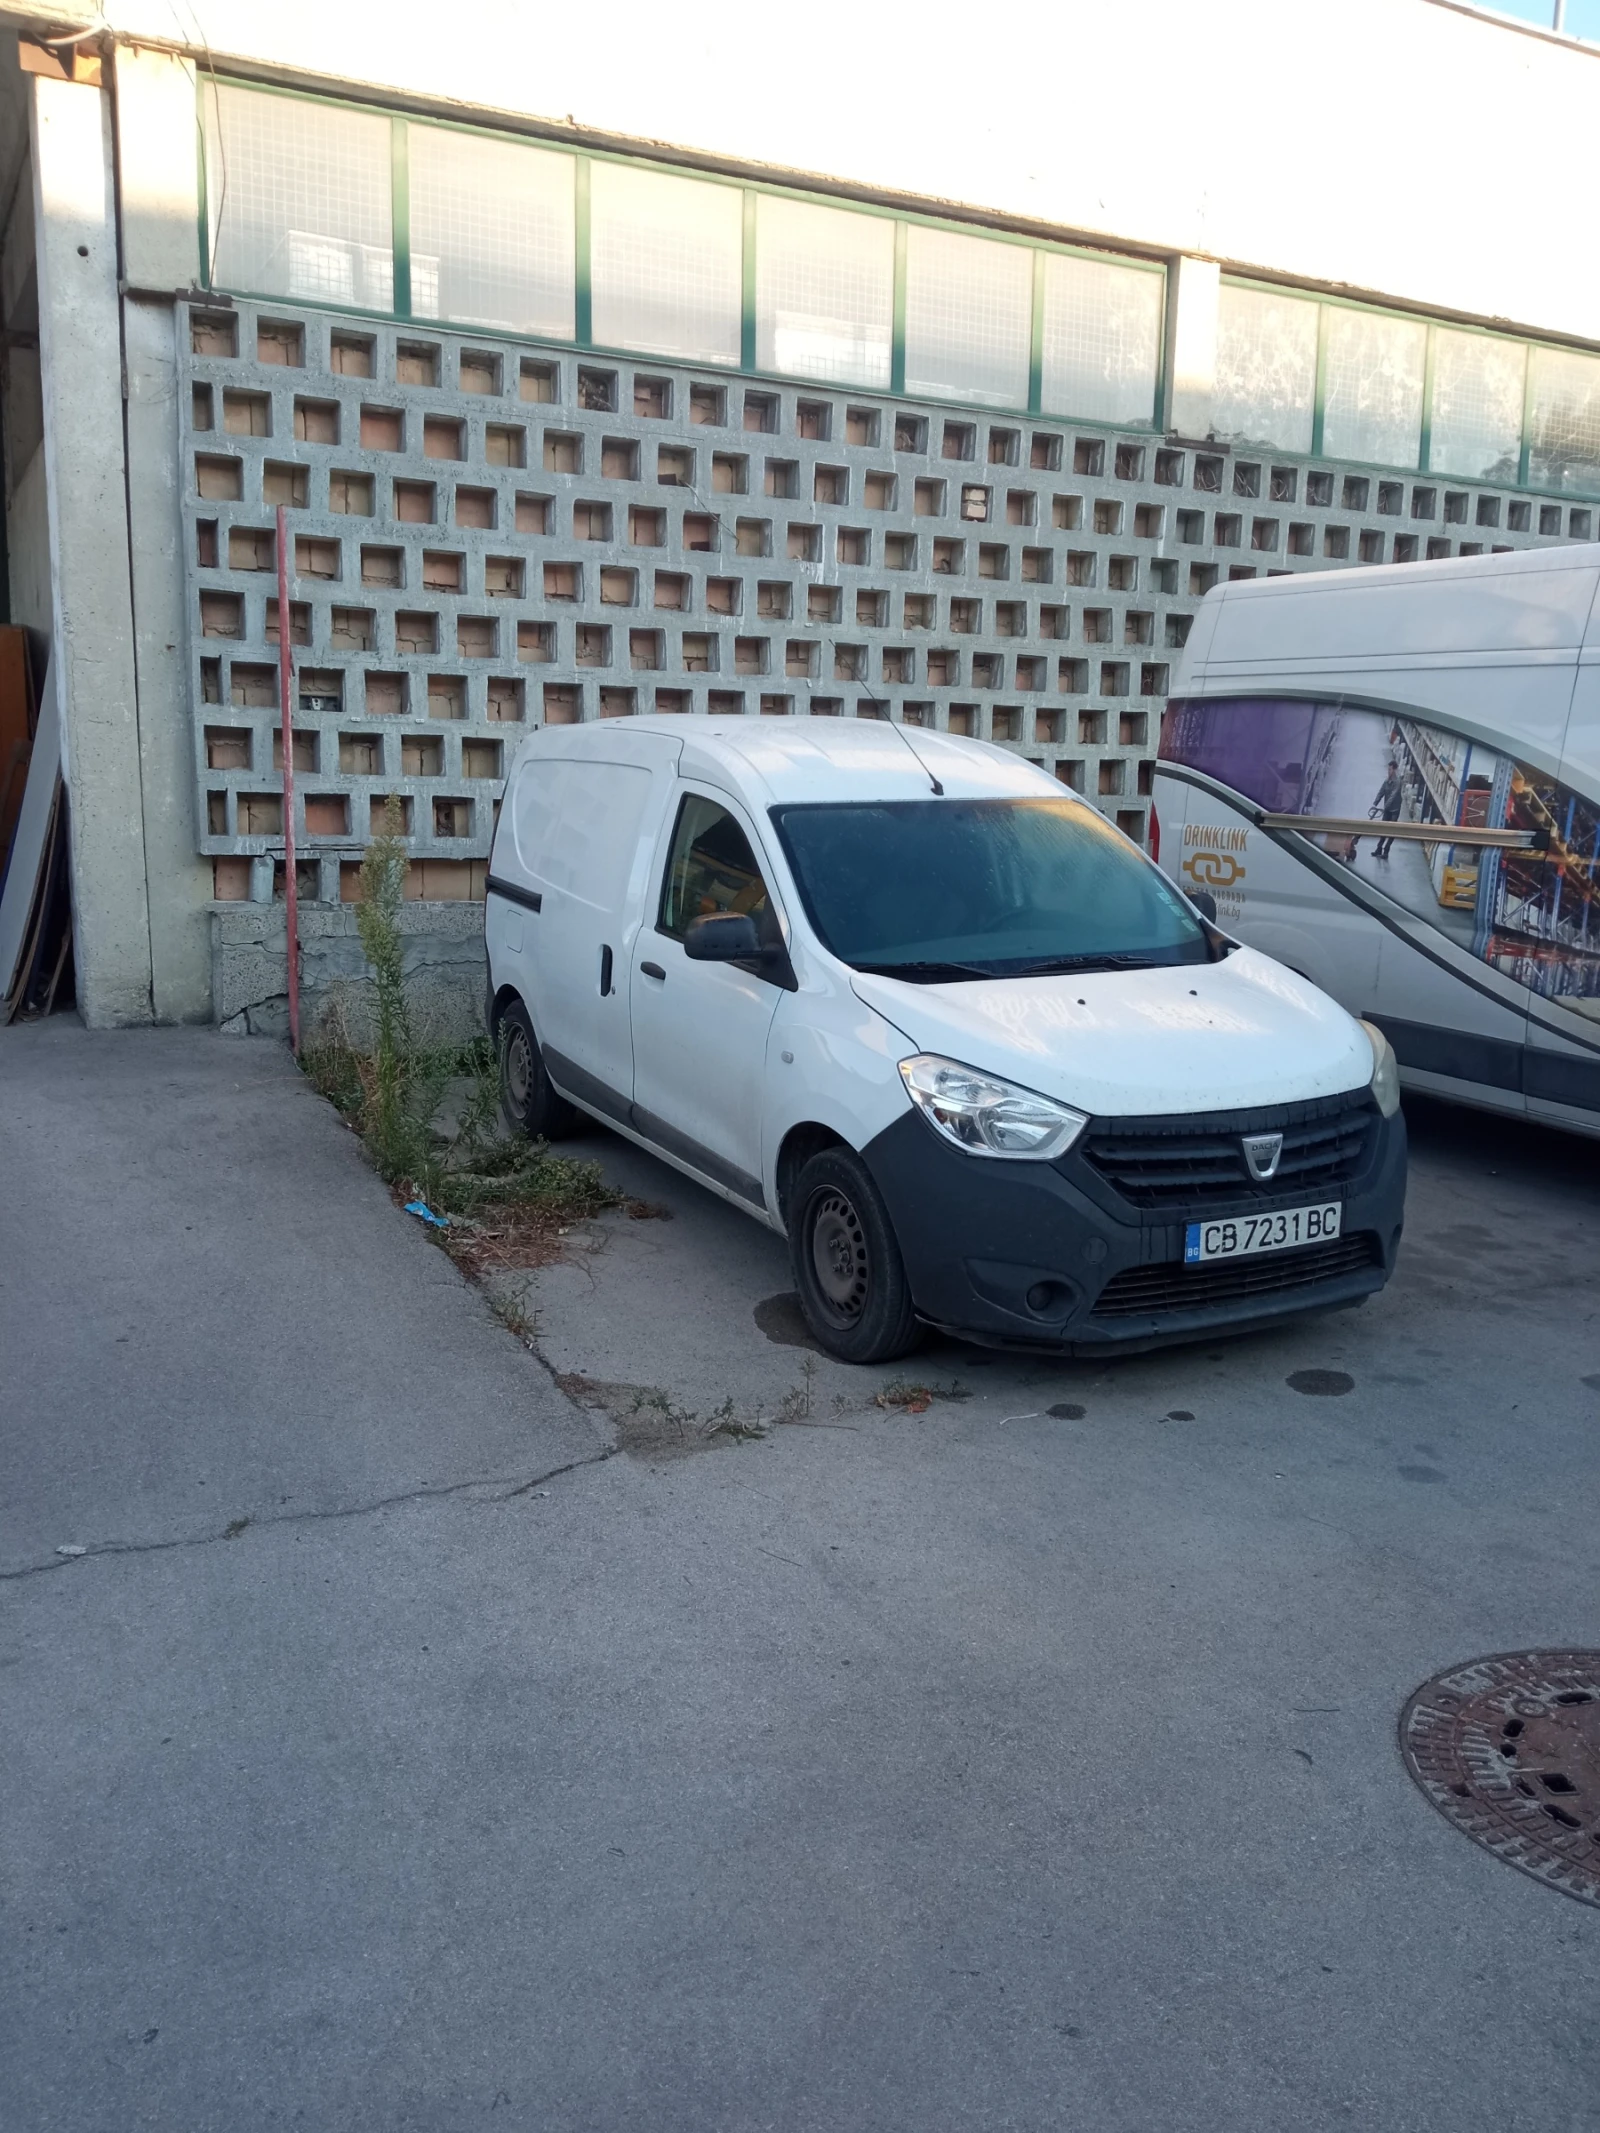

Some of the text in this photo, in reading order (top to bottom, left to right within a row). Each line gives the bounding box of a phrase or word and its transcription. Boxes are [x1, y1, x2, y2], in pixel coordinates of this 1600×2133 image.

[1184, 824, 1249, 851] DRINKLINK
[1216, 903, 1241, 920] link.bg
[1252, 1142, 1279, 1151] DACIA
[1187, 1247, 1199, 1257] BG
